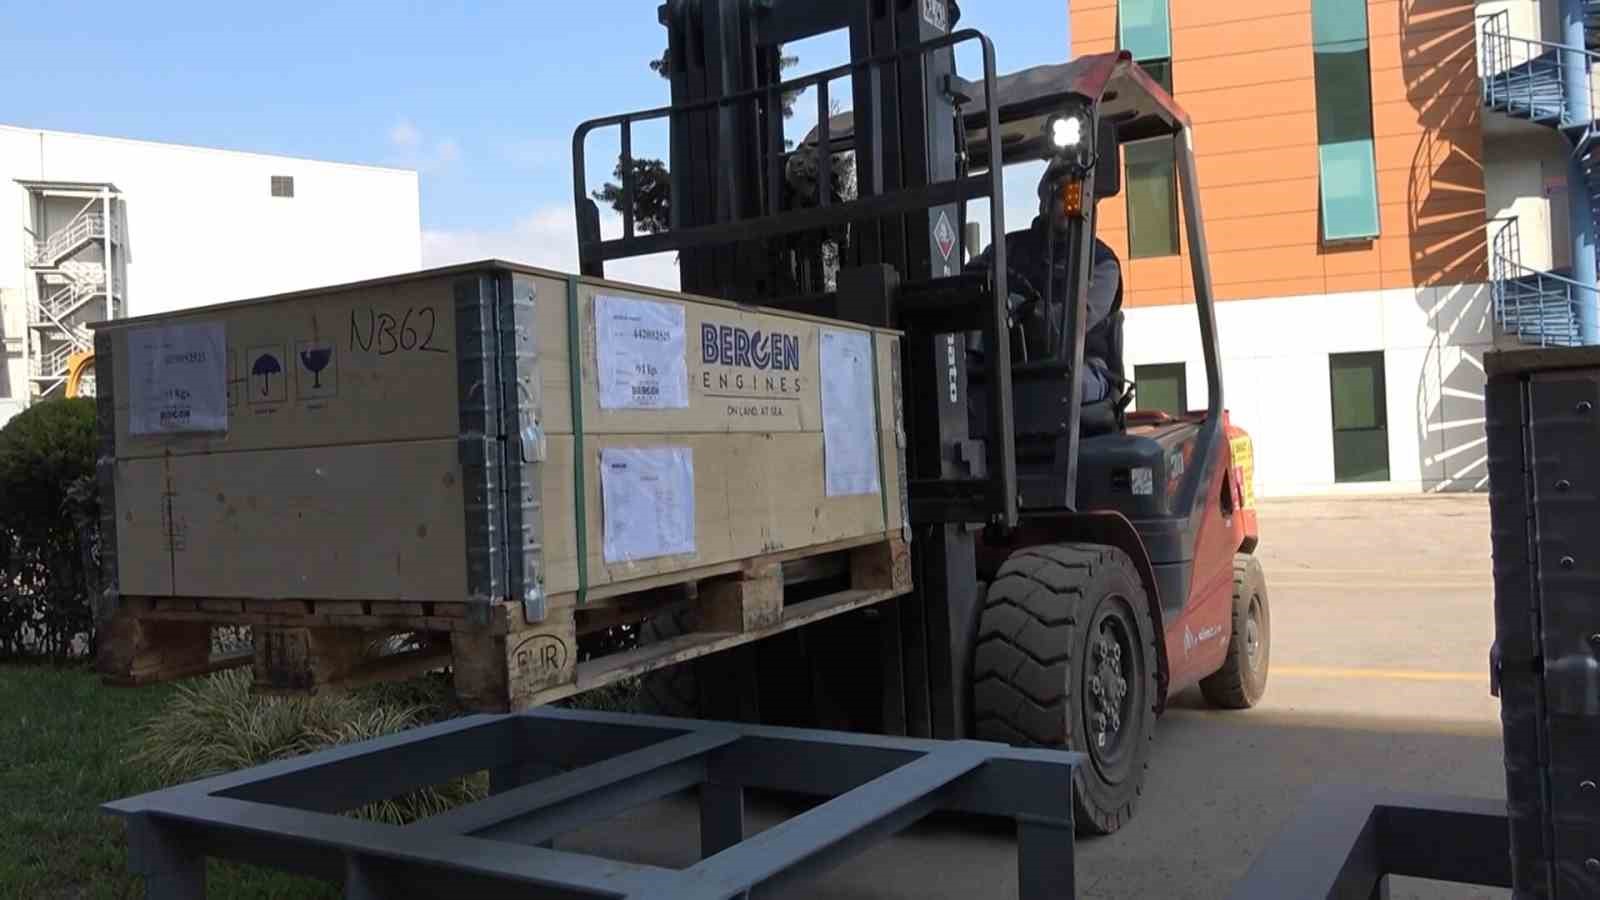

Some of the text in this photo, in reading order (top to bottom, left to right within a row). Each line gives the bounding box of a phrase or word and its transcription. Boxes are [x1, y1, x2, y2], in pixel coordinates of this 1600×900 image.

[351, 307, 448, 355] NB62
[702, 322, 800, 371] BERGEN
[703, 372, 801, 392] ENGINES
[727, 405, 738, 416] ON
[761, 407, 769, 416] AT
